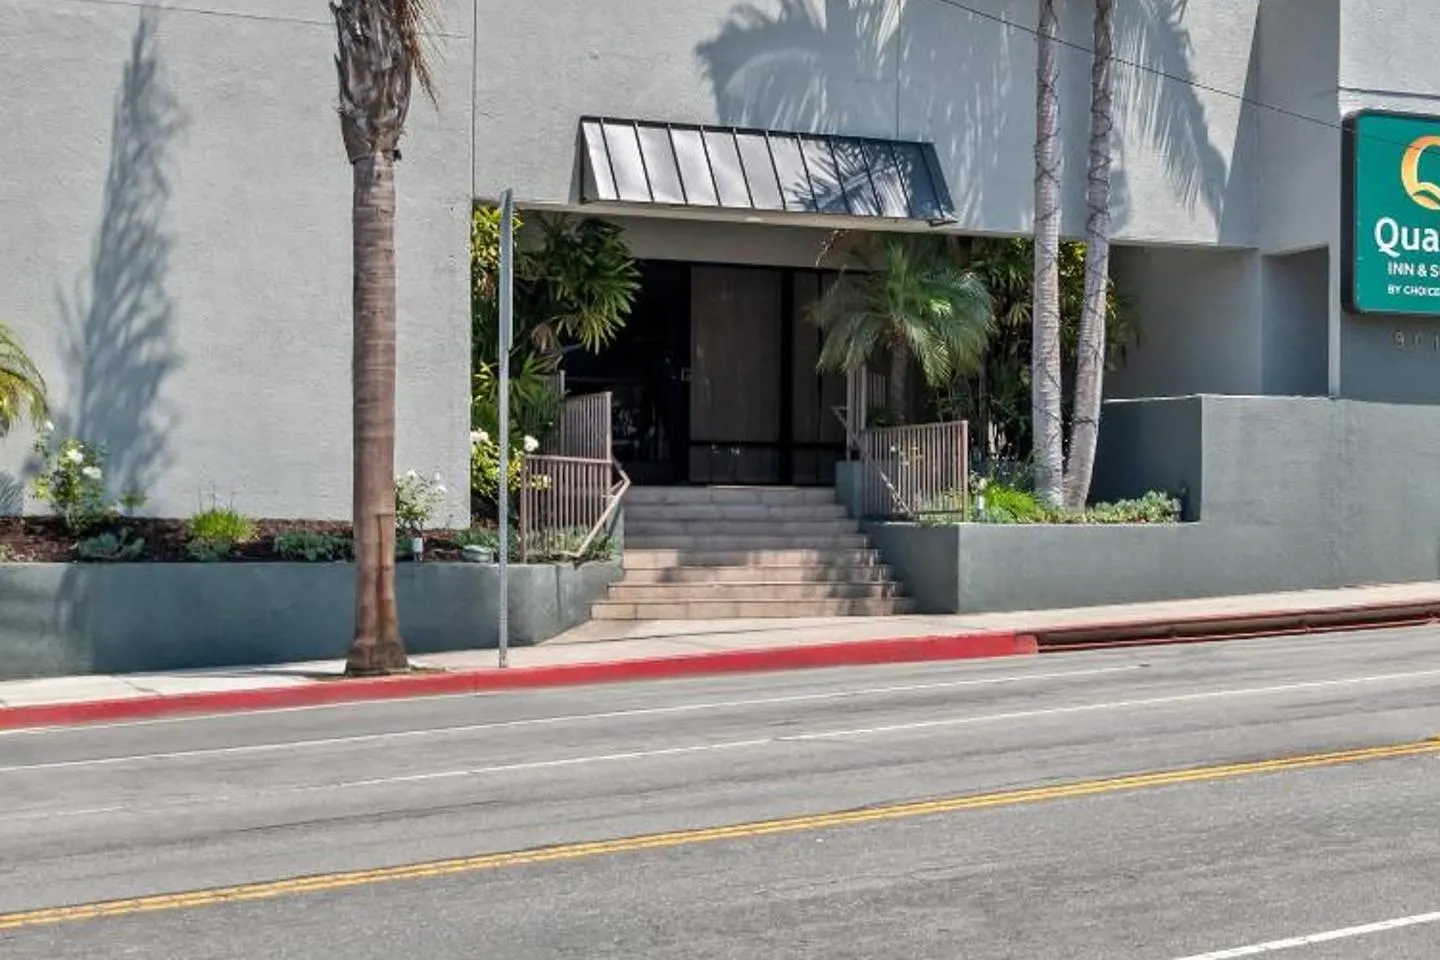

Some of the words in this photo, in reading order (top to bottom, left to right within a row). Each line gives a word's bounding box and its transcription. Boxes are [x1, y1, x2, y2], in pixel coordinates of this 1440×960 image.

[1388, 261, 1413, 276] INN
[1418, 263, 1427, 277] &
[1387, 285, 1401, 294] BY
[1403, 285, 1440, 297] CHOICE
